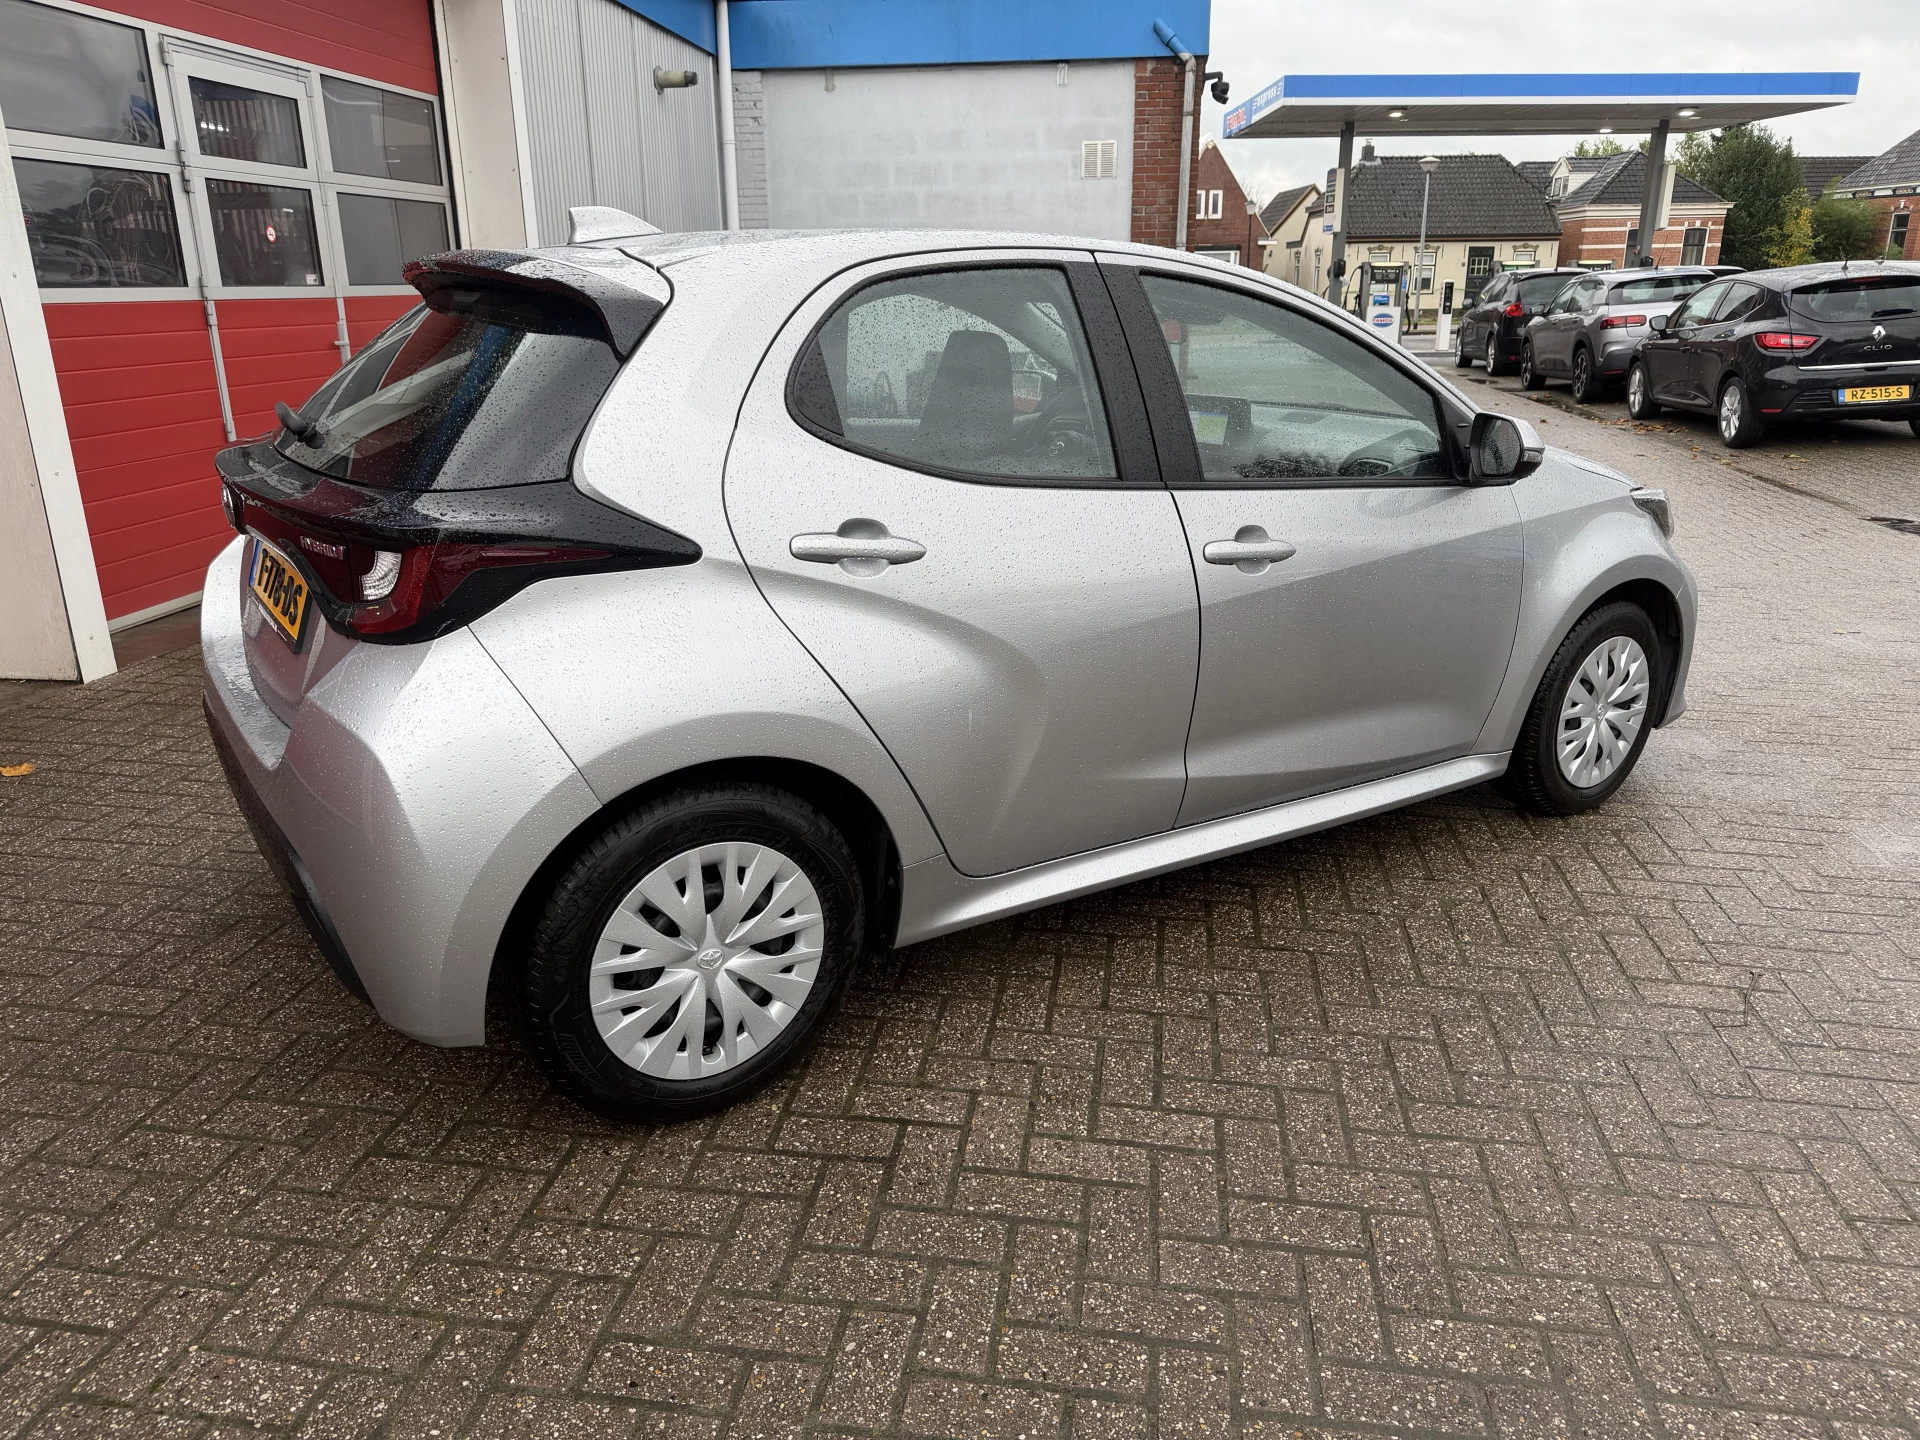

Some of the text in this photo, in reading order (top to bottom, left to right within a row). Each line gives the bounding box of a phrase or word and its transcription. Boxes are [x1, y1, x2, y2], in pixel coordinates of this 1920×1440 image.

[1863, 344, 1893, 352] CLIO
[1851, 386, 1903, 400] RZ-515-S
[300, 535, 346, 561] HYBRID
[257, 547, 303, 627] T-778-DS
